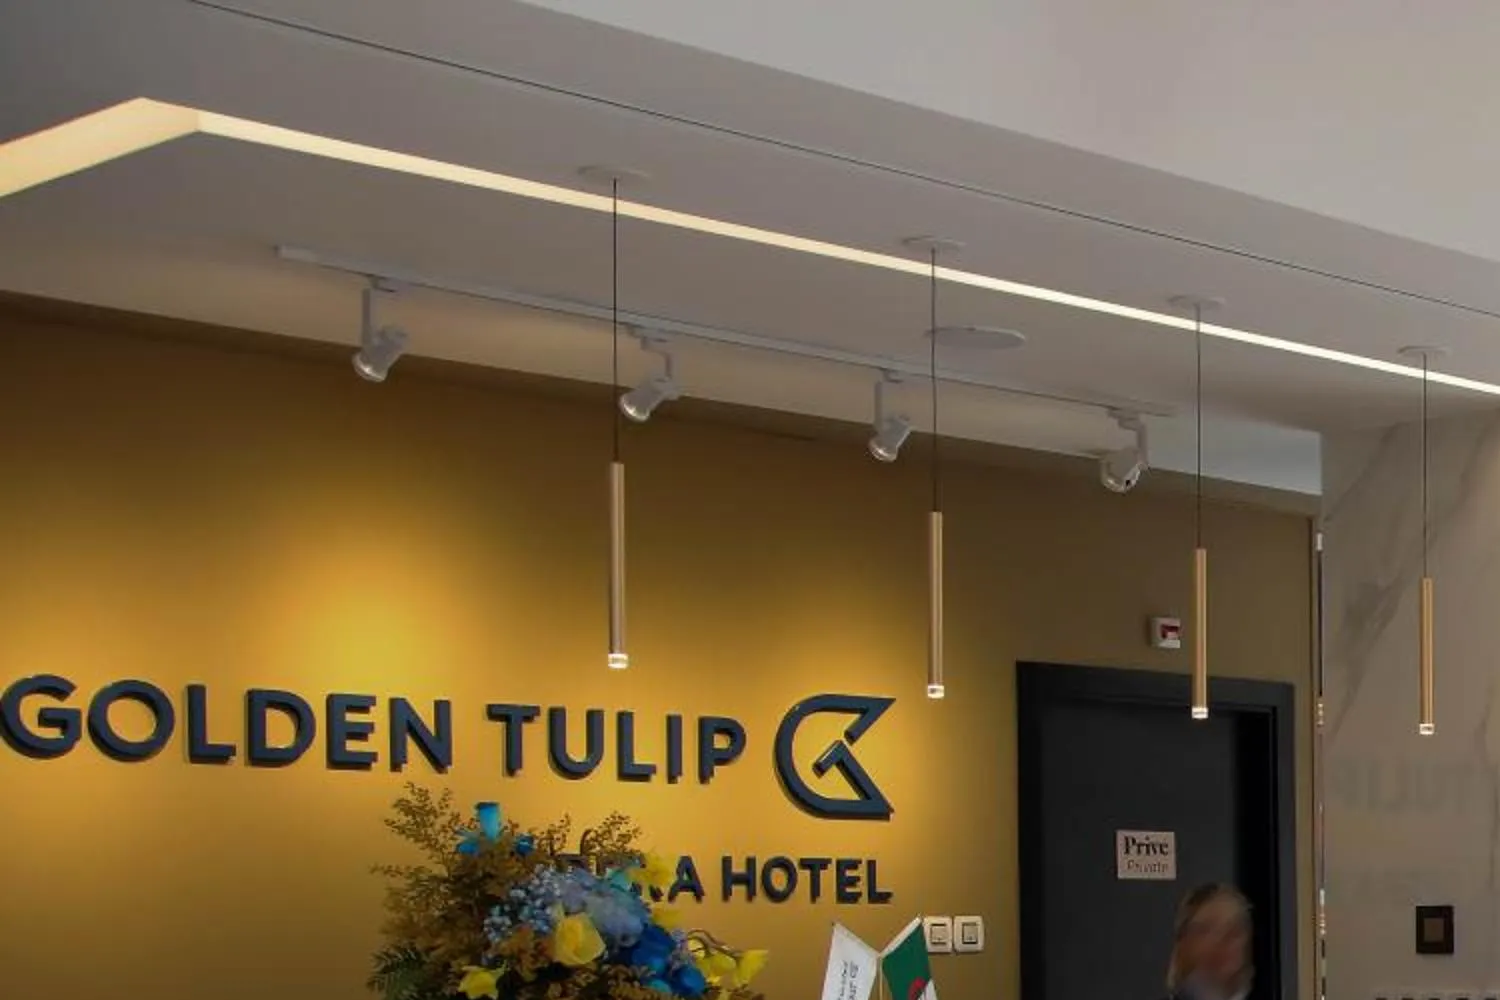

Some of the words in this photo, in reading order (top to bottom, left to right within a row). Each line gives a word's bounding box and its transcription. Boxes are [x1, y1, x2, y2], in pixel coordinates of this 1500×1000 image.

[0, 674, 454, 774] GOLDEN
[486, 702, 747, 785] TULIP
[721, 855, 893, 905] HOTEL
